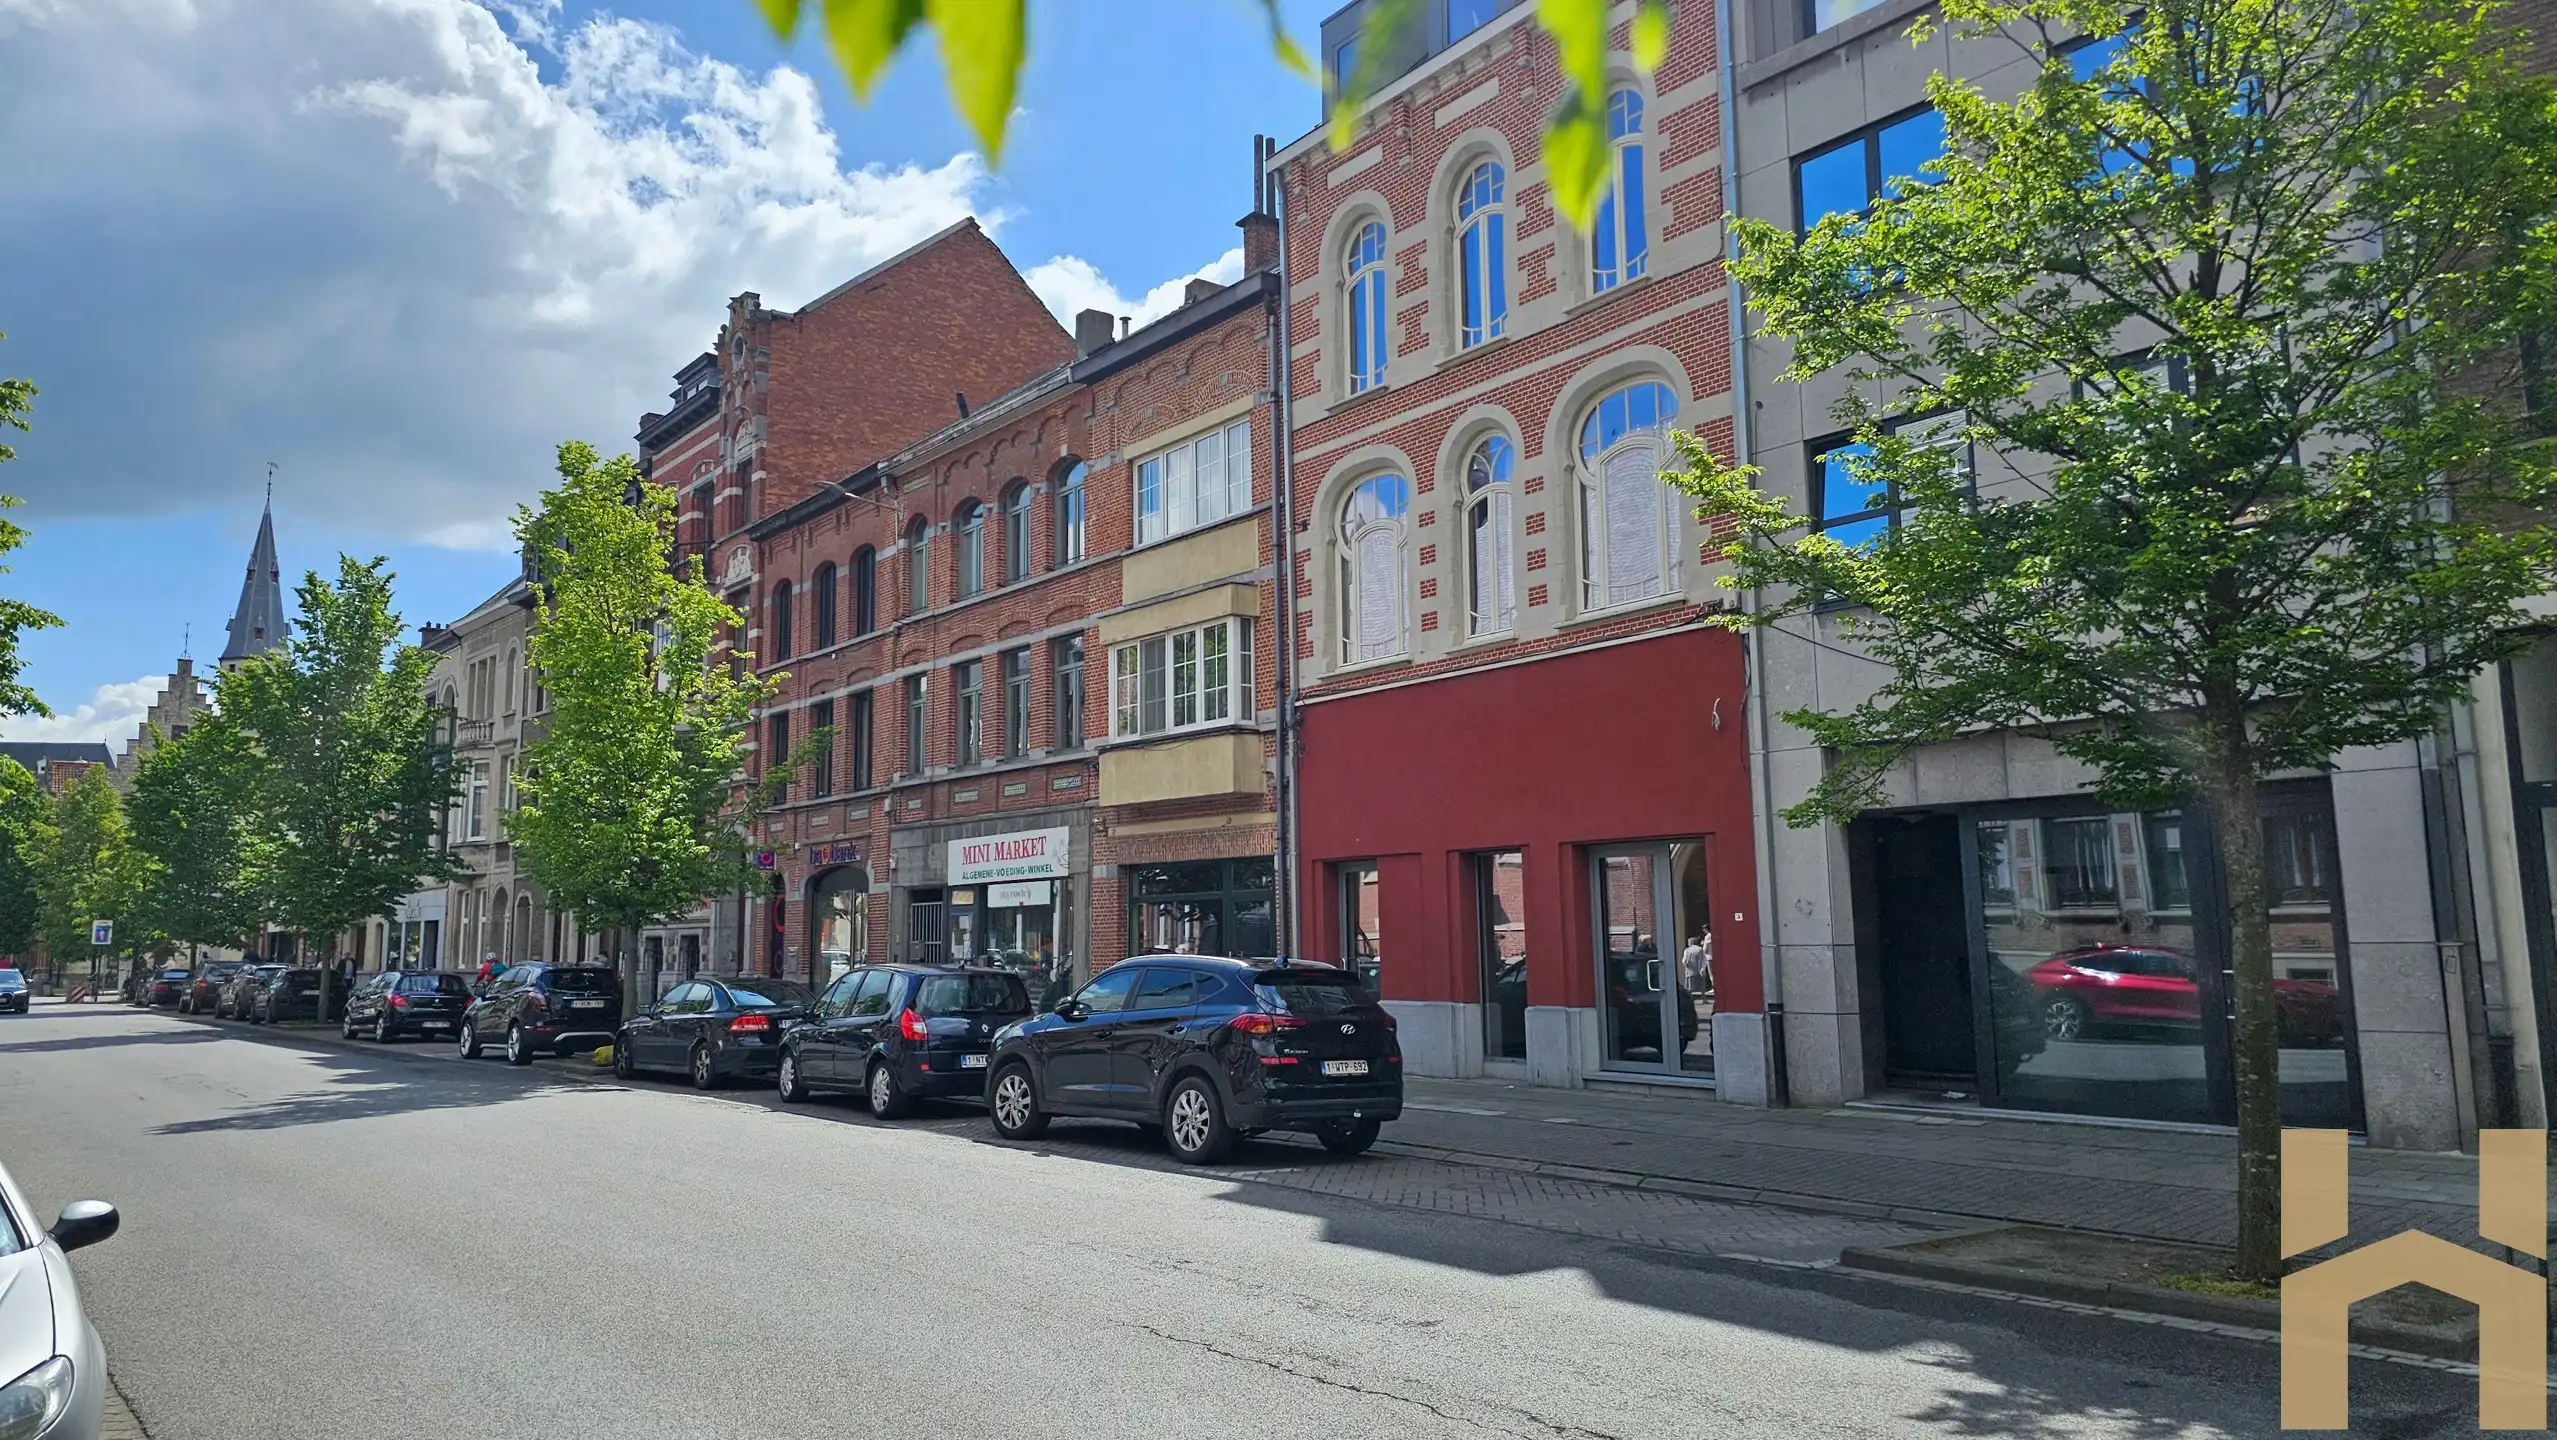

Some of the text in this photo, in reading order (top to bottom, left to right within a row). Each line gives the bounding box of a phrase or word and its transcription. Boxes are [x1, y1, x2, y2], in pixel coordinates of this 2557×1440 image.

[962, 835, 1047, 866] MINI MARKET
[1326, 1060, 1368, 1073] 1-WTP-692
